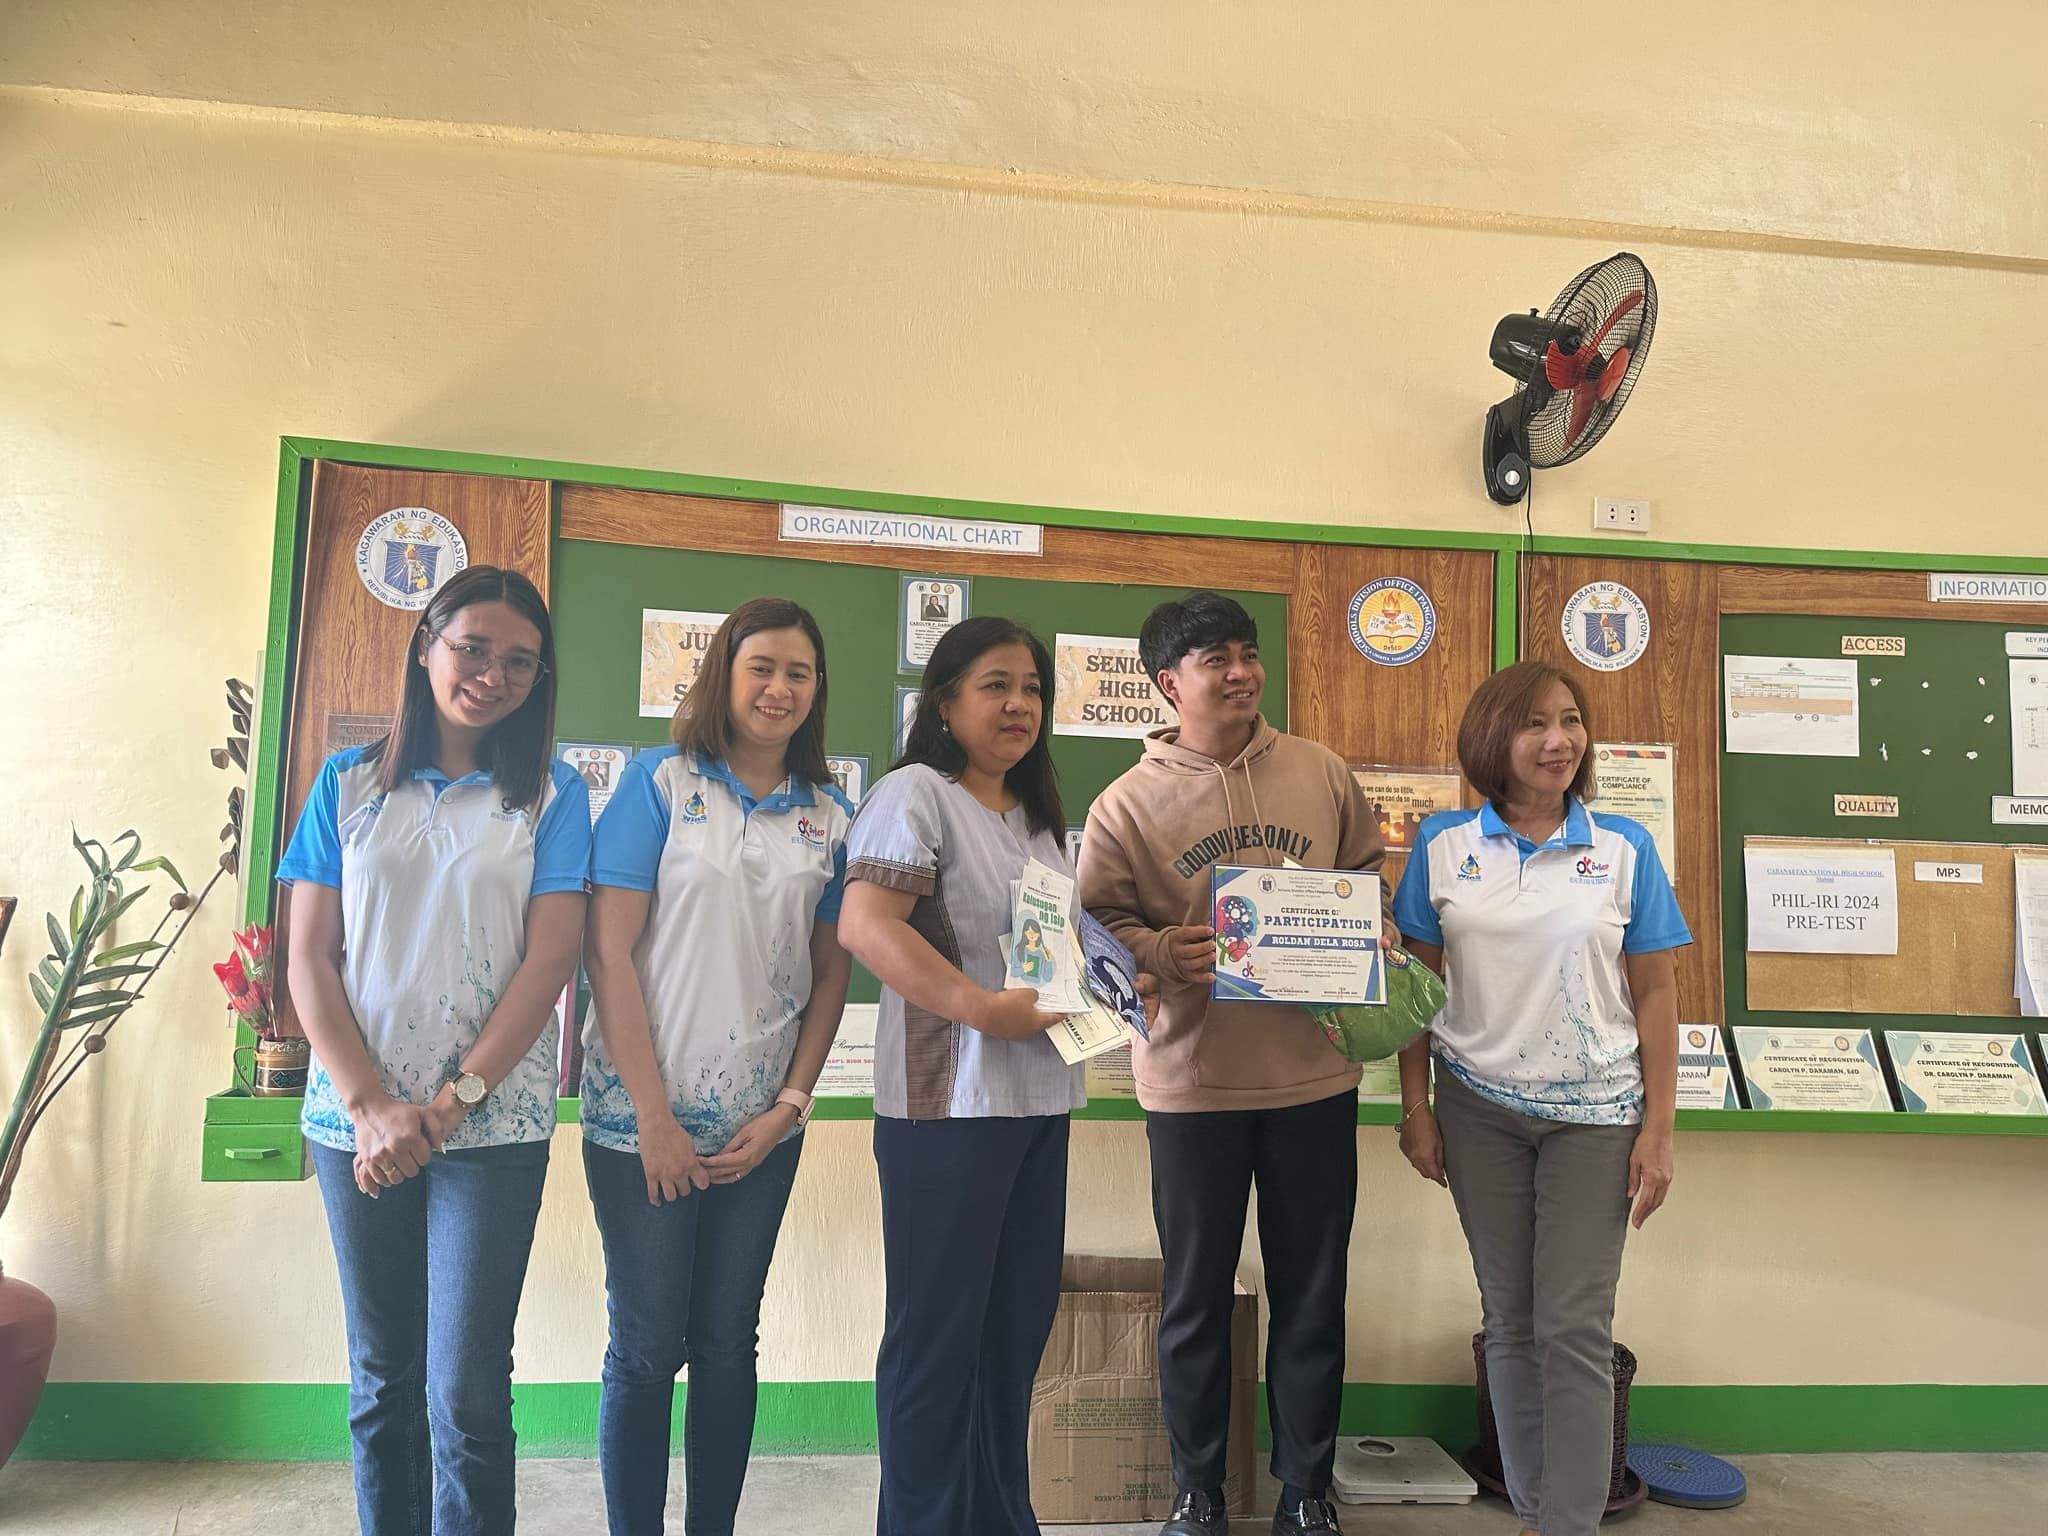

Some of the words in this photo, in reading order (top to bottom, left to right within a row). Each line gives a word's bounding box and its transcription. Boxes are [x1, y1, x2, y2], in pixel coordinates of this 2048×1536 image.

[359, 510, 405, 564] KAGAWARAN
[410, 510, 427, 520] NG
[794, 515, 957, 542] ORGANIZATIONAL
[962, 526, 1023, 546] CHART
[366, 579, 402, 606] REPUBLIKA
[1385, 579, 1416, 594] OFFICE
[1939, 580, 2048, 597] INFORMATIO
[1352, 581, 1383, 616] DIVISION
[1563, 585, 1597, 635] KAGAWARAN
[1600, 583, 1614, 592] NG
[1617, 587, 1648, 638] EDUKASYON
[1350, 613, 1370, 653] SCHOOLS
[1417, 596, 1433, 653] PANGASINAN
[678, 632, 721, 650] JU
[1843, 638, 1904, 652] ACCESS
[1573, 646, 1603, 669] REPUBLIKA
[1099, 679, 1151, 699] HIGH
[1081, 703, 1167, 724] SCHOOL
[1597, 775, 1641, 783] CERTIFICATE
[1602, 782, 1647, 790] COMPLIANCE
[1375, 785, 1385, 793] can
[1386, 785, 1393, 793] do
[1412, 796, 1434, 809] much
[1837, 800, 1897, 813] QUALITY
[1809, 869, 1840, 877] NATIONAL
[1936, 867, 1961, 878] MPS
[1023, 891, 1057, 913] Kalusugan
[1771, 893, 1840, 909] PHIL-IRI
[1843, 895, 1880, 910] 2024
[1039, 910, 1049, 924] ng
[1281, 907, 1330, 916] CERTIFICATE
[1264, 915, 1373, 930] PARTICIPATION
[1786, 914, 1867, 931] PRE-TEST
[1271, 936, 1311, 947] ROLDAN
[1313, 938, 1339, 948] DELA
[1342, 939, 1366, 948] ROSA
